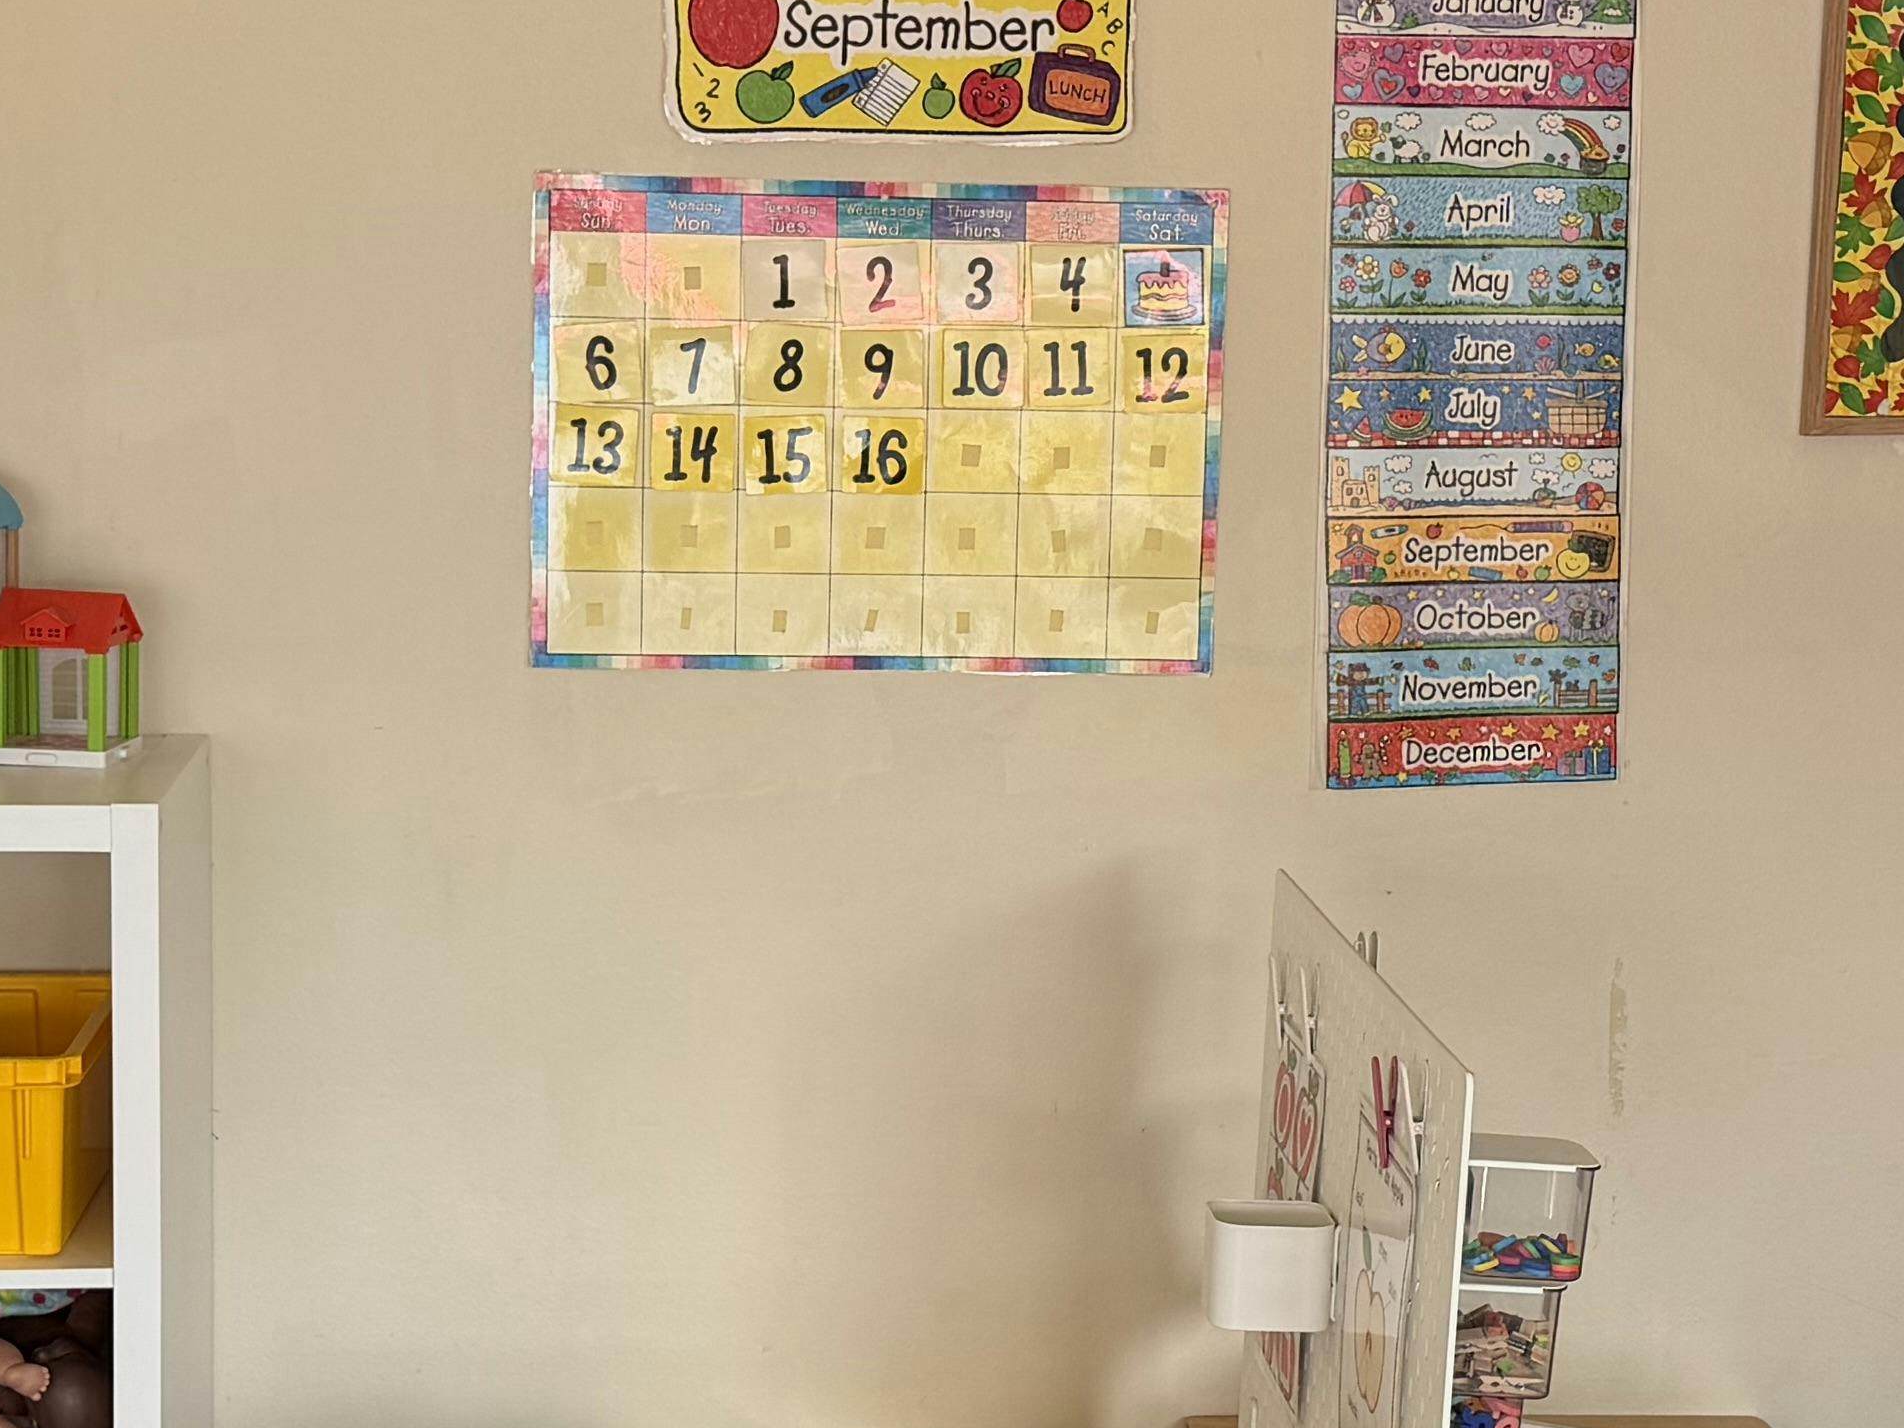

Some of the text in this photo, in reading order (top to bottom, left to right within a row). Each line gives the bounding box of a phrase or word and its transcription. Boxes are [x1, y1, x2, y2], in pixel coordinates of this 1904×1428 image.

[1097, 2, 1109, 19] A
[1107, 19, 1123, 34] B
[1101, 40, 1115, 56] C
[1422, 55, 1550, 93] February
[707, 78, 720, 98] 2
[1049, 79, 1106, 105] LUNCH
[694, 101, 712, 122] 3
[1440, 130, 1531, 159] March
[667, 199, 722, 215] Monday
[763, 202, 817, 217] Tuesday
[847, 204, 924, 219] Wednesday
[945, 204, 1012, 222] Thursday
[1135, 209, 1198, 227] Saturday
[1448, 195, 1510, 231] April
[770, 254, 1086, 312] 1 2 3 4
[1451, 268, 1510, 304] May
[1451, 339, 1512, 363] June
[584, 334, 1190, 404] 6 7 8 9 10 11 12
[1447, 392, 1499, 427] July
[568, 417, 908, 485] 13 14 15 16
[1425, 461, 1518, 497] August
[1405, 537, 1549, 570] September
[1416, 604, 1536, 631] October
[1401, 672, 1537, 701] November
[1405, 739, 1541, 765] December
